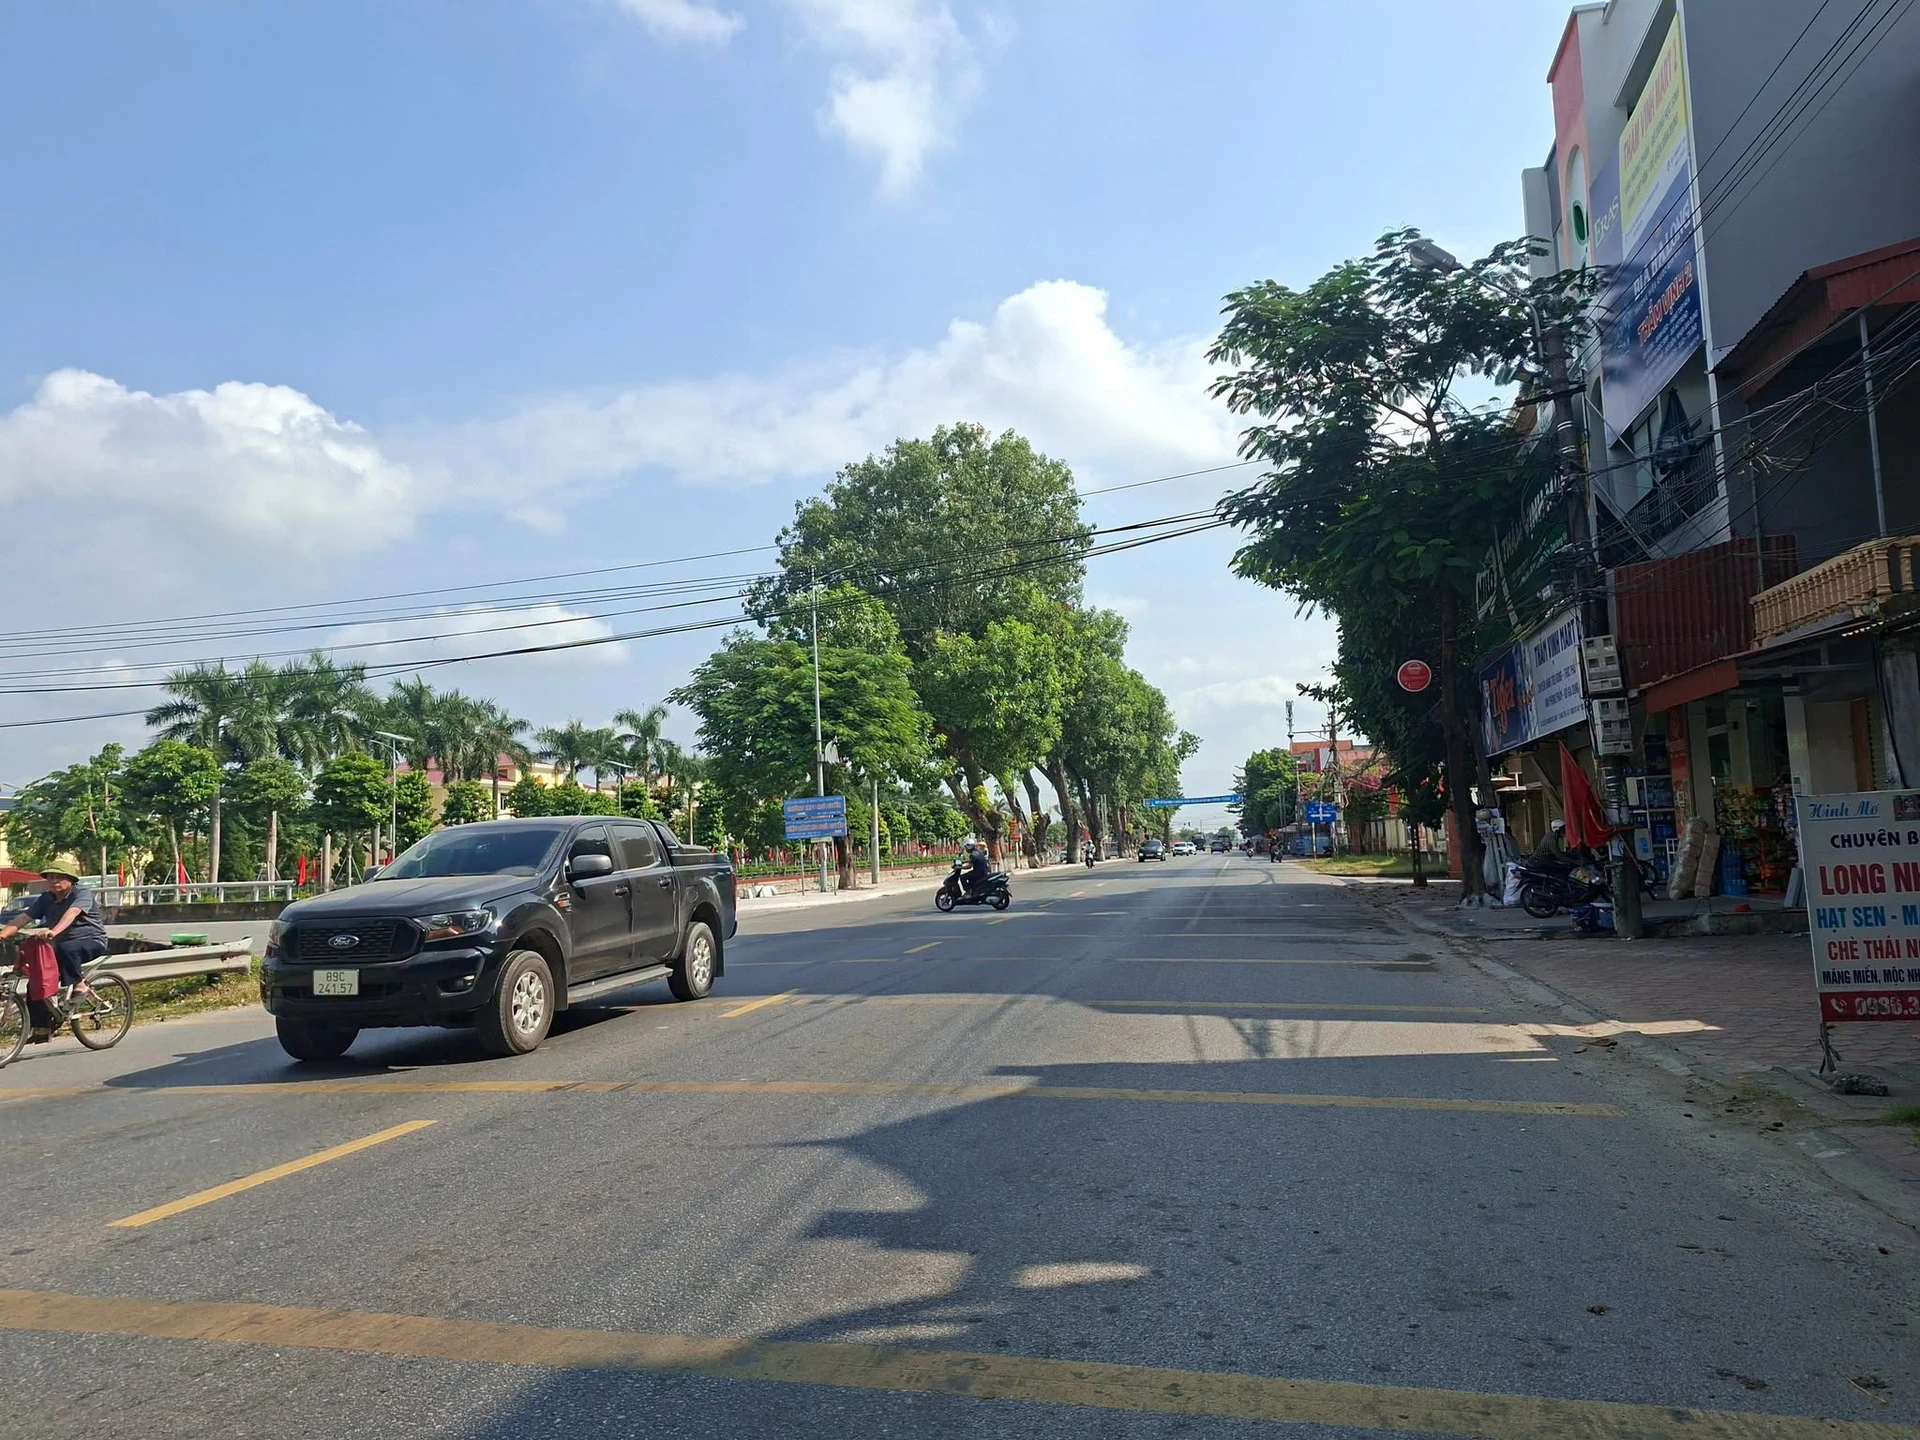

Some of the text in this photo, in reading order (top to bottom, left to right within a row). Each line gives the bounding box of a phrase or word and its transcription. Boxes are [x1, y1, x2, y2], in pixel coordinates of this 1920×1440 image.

[1830, 828, 1900, 848] CHUYÊN
[1820, 863, 1886, 895] LONG
[1817, 907, 1846, 932] HẠT
[1853, 905, 1886, 928] SEN
[1901, 904, 1920, 926] M
[333, 937, 351, 946] Ford
[1828, 935, 1920, 960] CHÈ THÁI N
[326, 972, 345, 982] 89C
[1822, 967, 1850, 984] MĂNG
[1883, 965, 1904, 985] MỘC
[318, 983, 353, 994] 241.57
